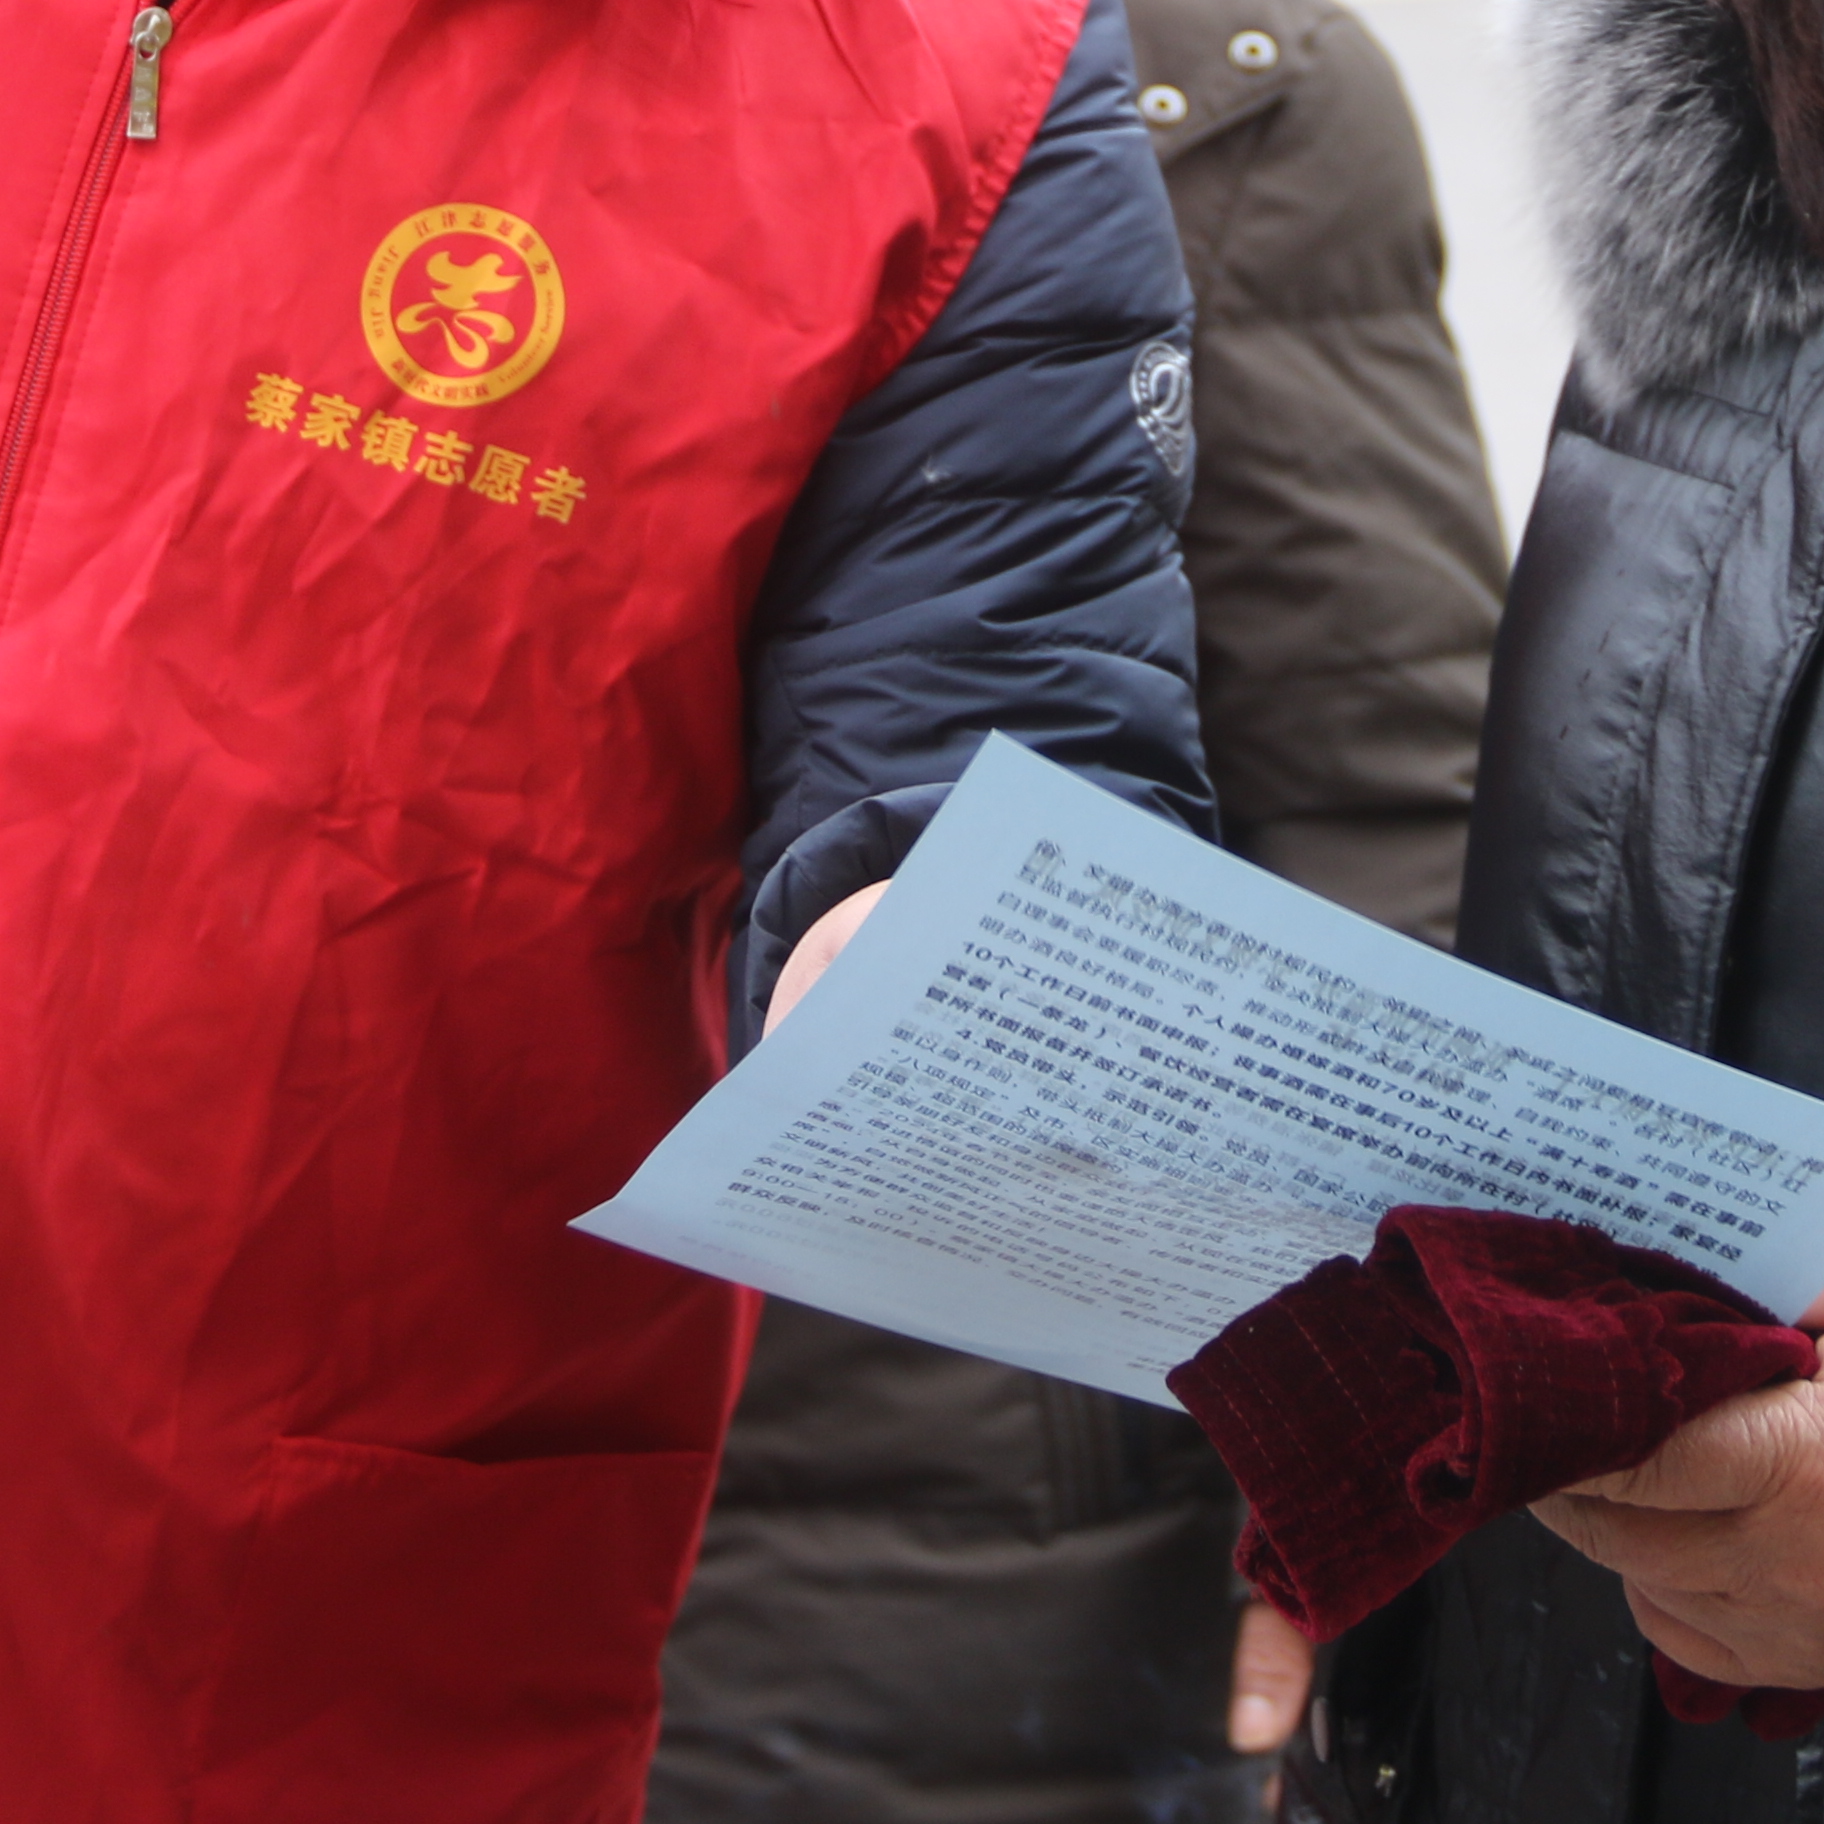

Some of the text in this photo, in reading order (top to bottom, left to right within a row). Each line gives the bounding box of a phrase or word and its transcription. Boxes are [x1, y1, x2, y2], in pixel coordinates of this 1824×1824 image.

[244, 371, 588, 526] 蔡家镇志愿者
